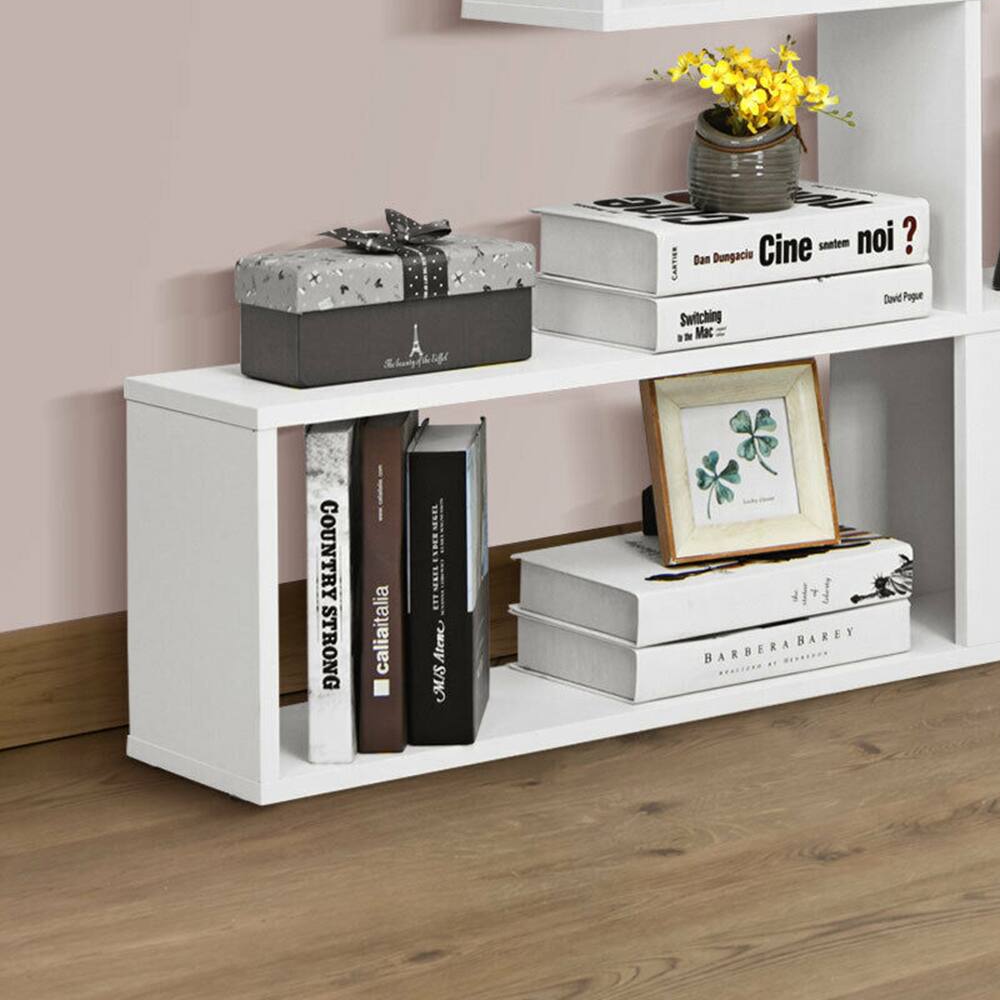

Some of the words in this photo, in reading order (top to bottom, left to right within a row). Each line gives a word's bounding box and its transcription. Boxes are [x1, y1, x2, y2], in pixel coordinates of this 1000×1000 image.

[693, 254, 711, 266] Dan
[713, 248, 754, 264] Dungaciu
[759, 233, 813, 267] Cine
[857, 219, 894, 255] noi
[902, 215, 917, 255] ?
[884, 292, 902, 305] David
[903, 291, 924, 304] Pogue
[679, 309, 722, 328] Switching
[684, 332, 693, 342] the
[695, 326, 714, 340] Mac
[320, 500, 339, 601] COUNTRY
[322, 606, 340, 690] STRONG
[704, 640, 790, 664] BARBERA
[797, 626, 854, 647] BAREY
